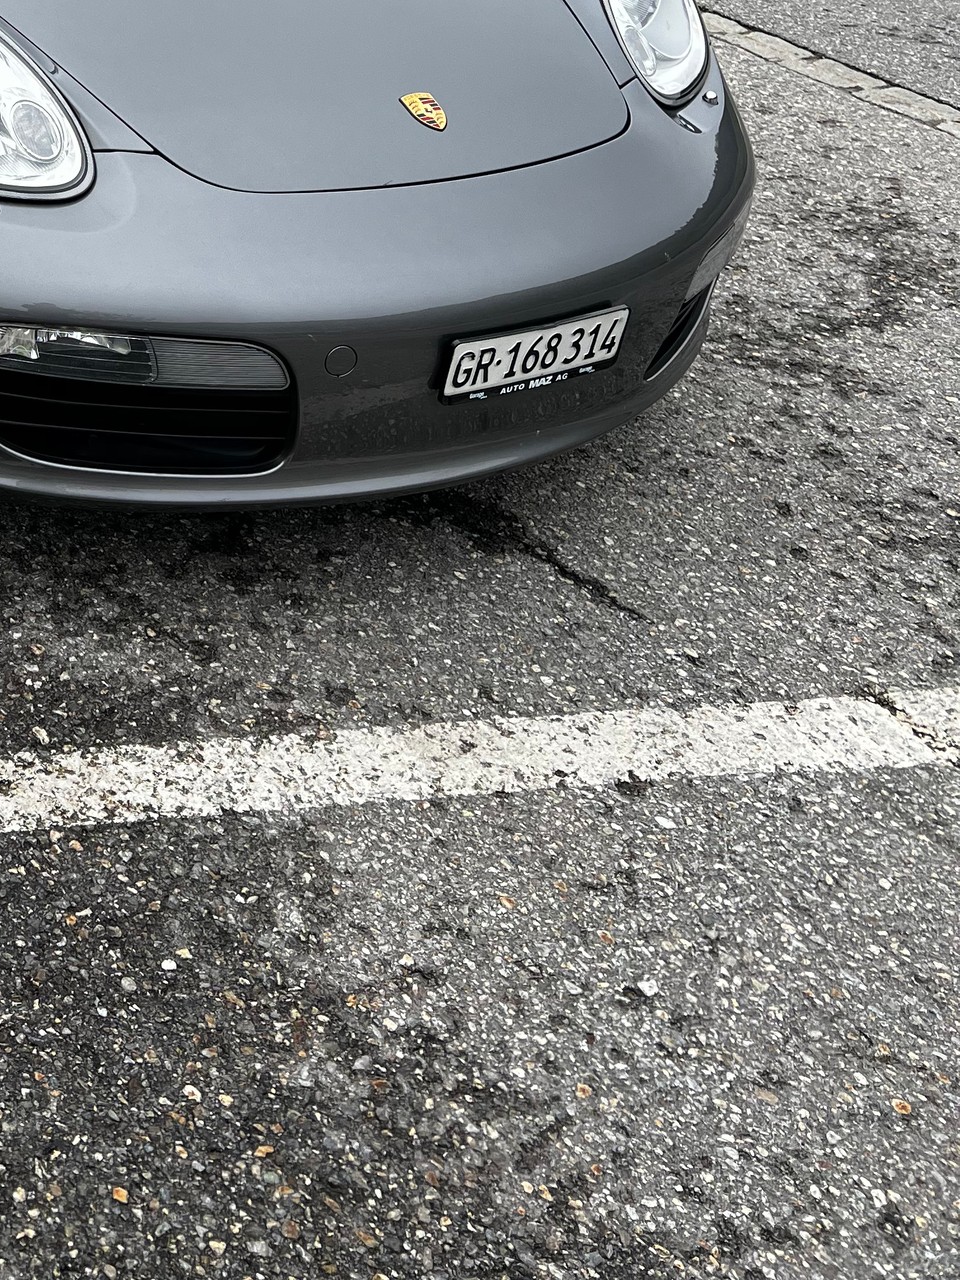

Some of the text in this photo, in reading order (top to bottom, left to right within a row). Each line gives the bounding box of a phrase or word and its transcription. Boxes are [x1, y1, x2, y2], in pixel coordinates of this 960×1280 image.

[499, 373, 569, 395] AUTO MAZ AG
